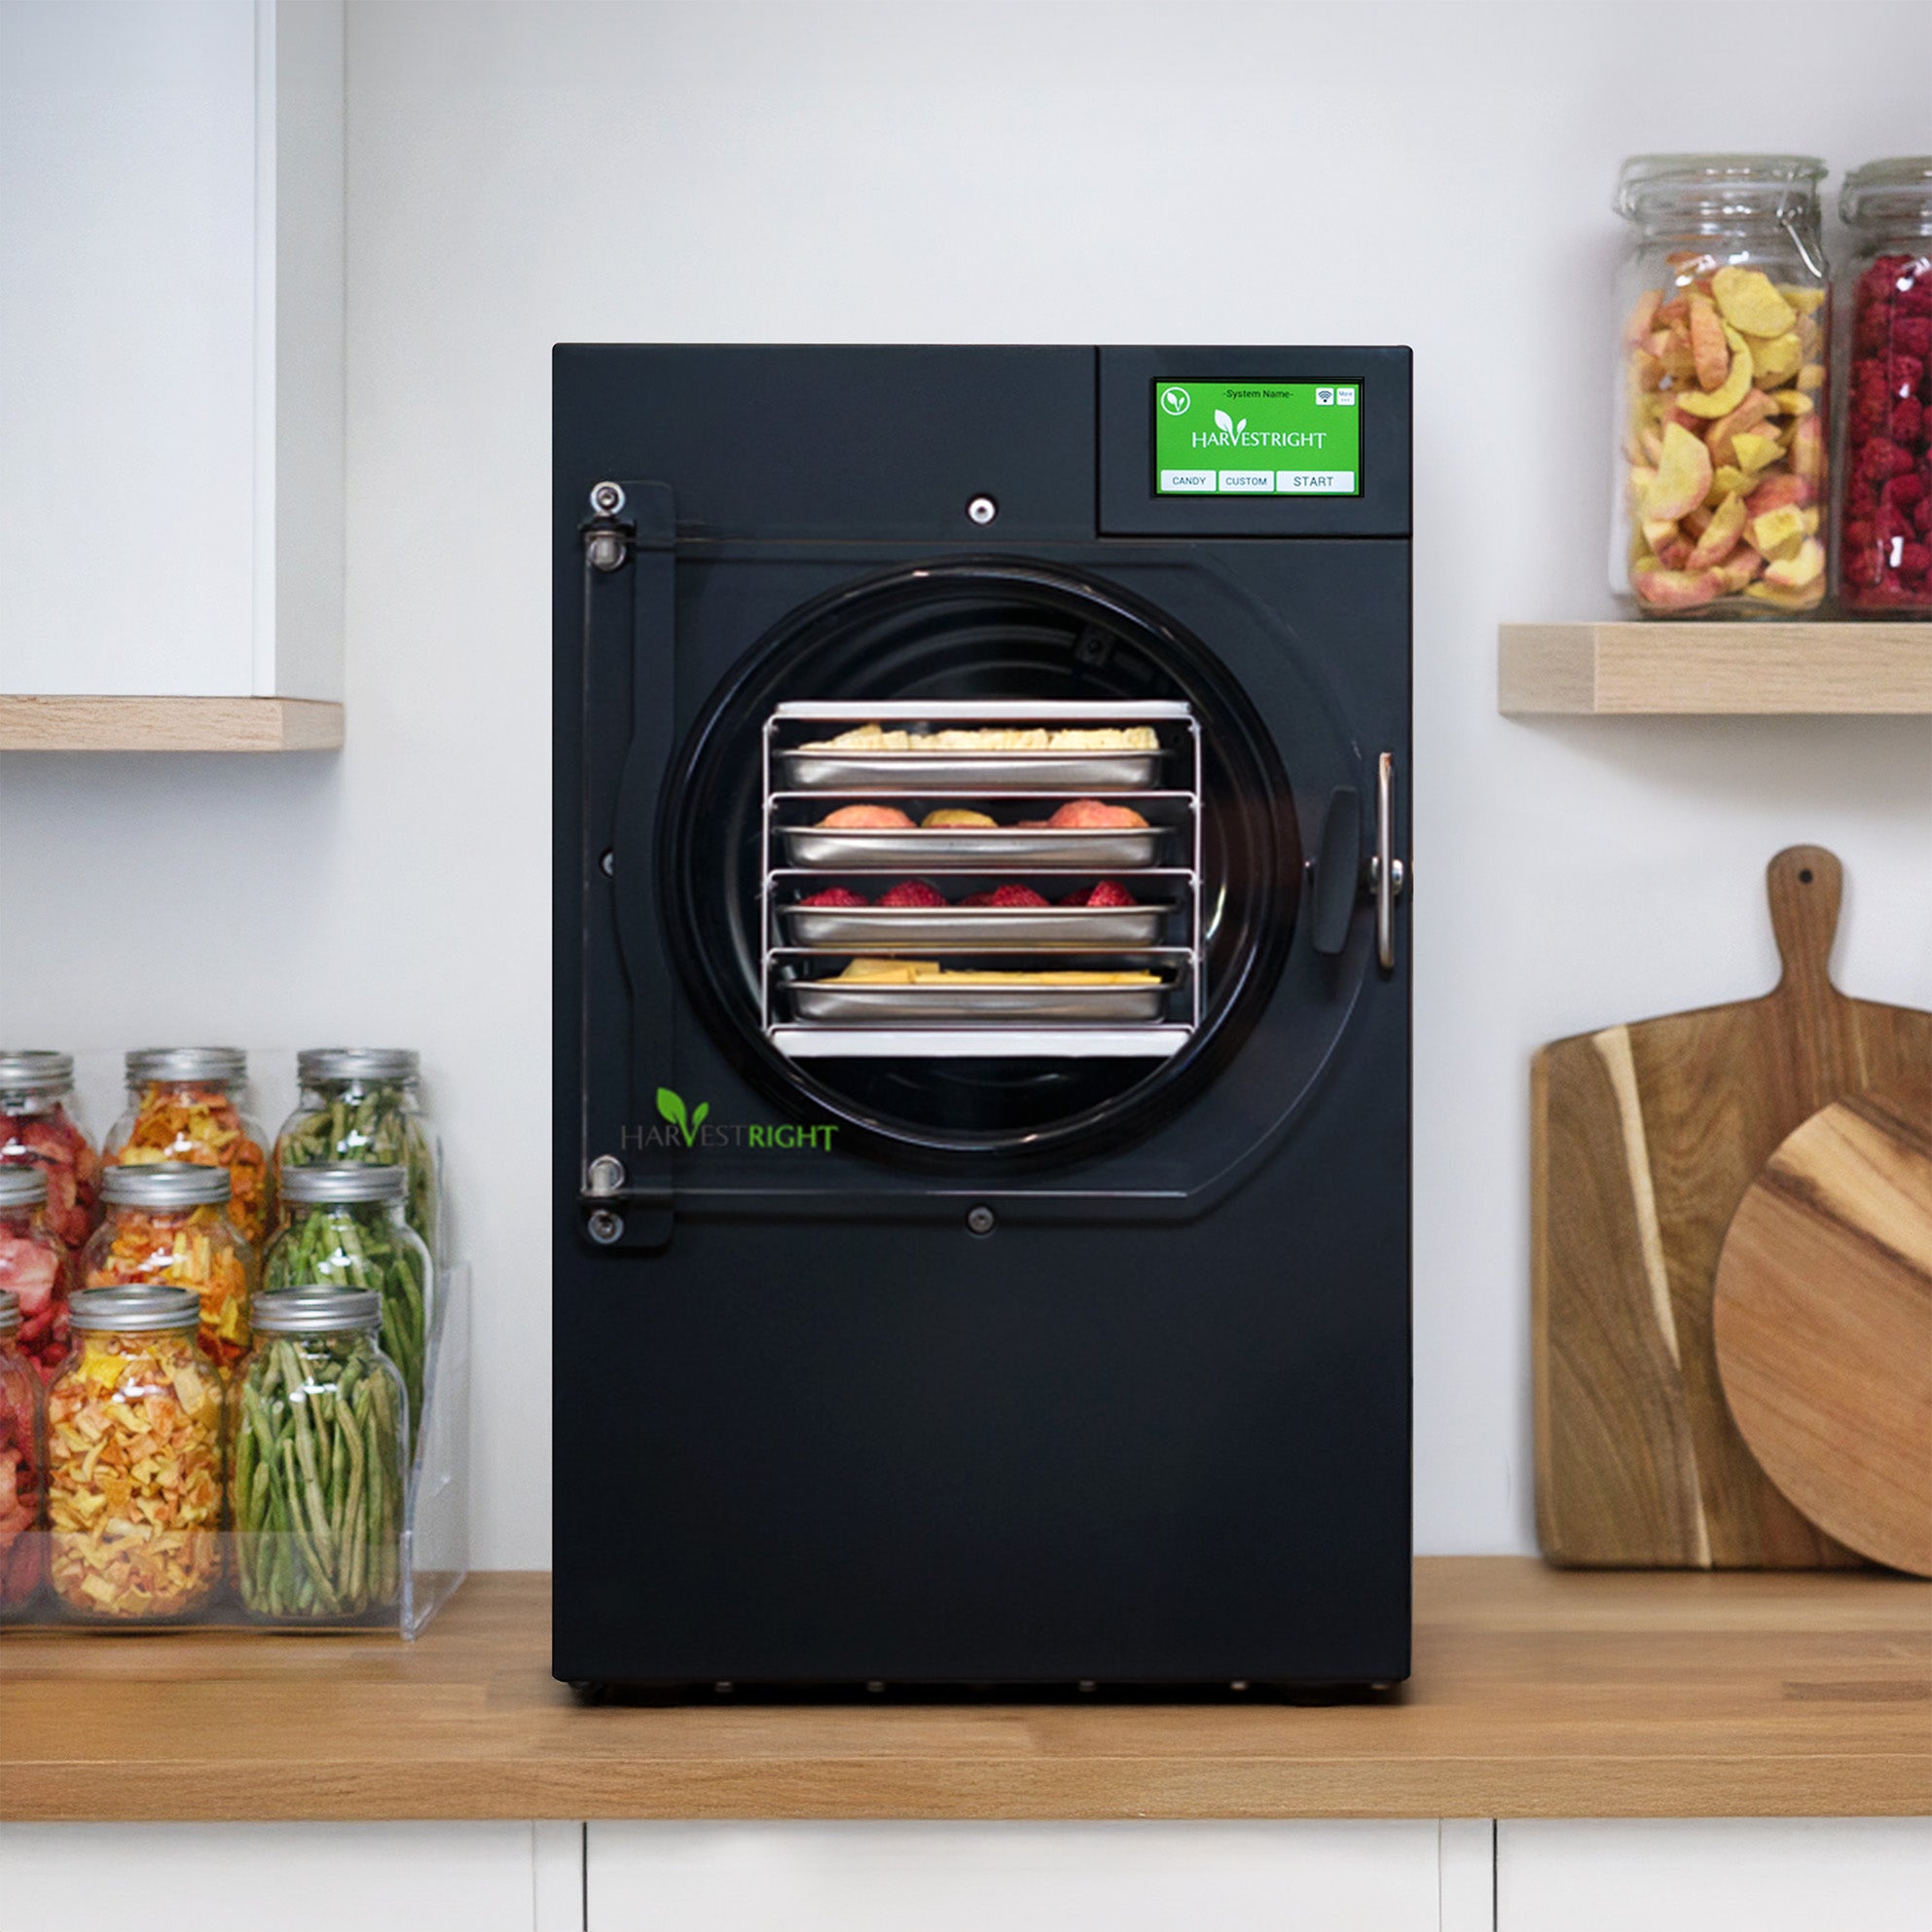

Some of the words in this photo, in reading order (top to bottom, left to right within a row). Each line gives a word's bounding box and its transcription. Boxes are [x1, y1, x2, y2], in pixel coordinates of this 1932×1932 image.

[1172, 476, 1206, 486] CANDY
[1225, 476, 1267, 486] CUSTOM
[1294, 476, 1333, 487] START
